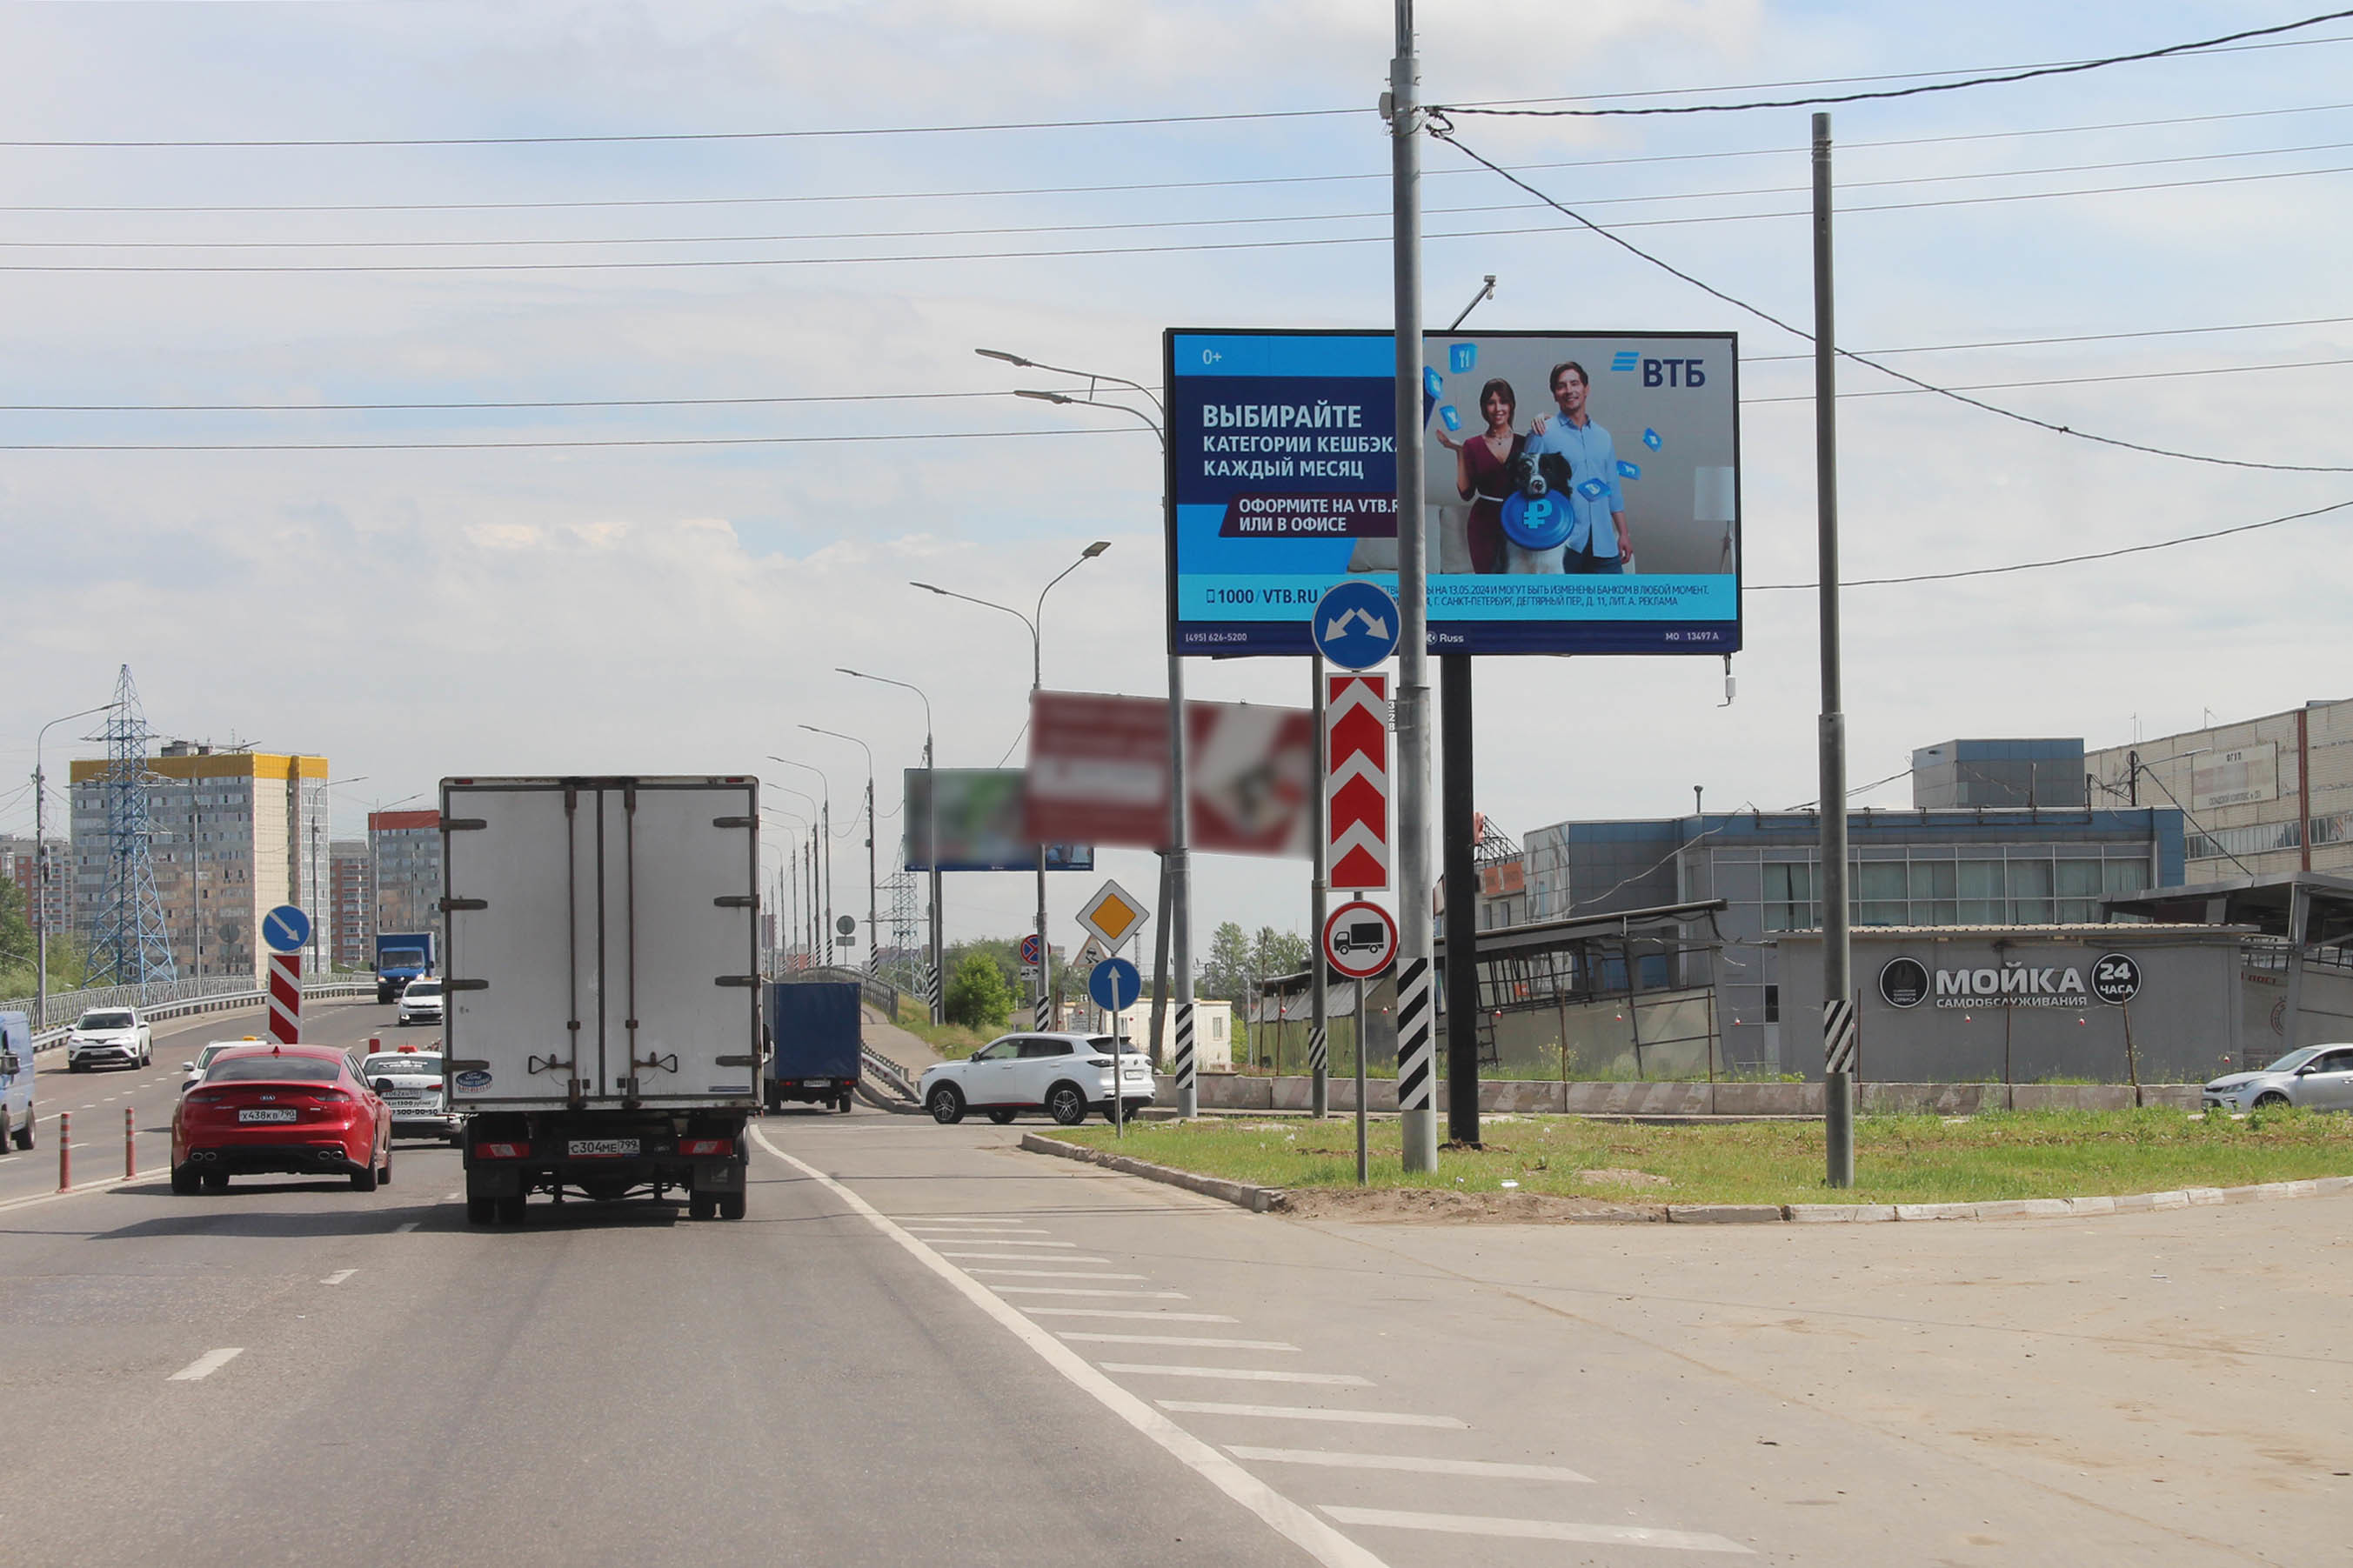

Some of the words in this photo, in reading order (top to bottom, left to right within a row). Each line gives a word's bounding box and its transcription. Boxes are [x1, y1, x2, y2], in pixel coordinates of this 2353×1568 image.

[1202, 349, 1222, 364] 0+
[1643, 358, 1706, 387] ВТБ
[1203, 399, 1362, 428] ВЫБИРАЙТЕ
[1203, 436, 1314, 452] КАТЕГОРИИ
[1317, 437, 1398, 453] КЕШБЭК
[1204, 457, 1294, 479] КАЖДЫЙ
[1300, 461, 1364, 479] МЕСЯЦ
[1239, 498, 1329, 513] ОФОРМИТЕ
[1333, 499, 1354, 513] НА
[1358, 499, 1398, 513] VTB.R
[1239, 517, 1273, 531] ИЛИ
[1277, 517, 1287, 530] В
[1291, 517, 1347, 531] ОФИСЕ
[1448, 585, 1489, 595] 13.05.2024
[1498, 585, 1525, 595] МОГУТ
[1527, 585, 1549, 595] БЫТЬ
[1550, 585, 1596, 595] ИЗМЕНЕНЫ
[1597, 585, 1633, 595] БАНКОМ
[1640, 584, 1672, 595] ЛЮБОЙ
[1672, 585, 1709, 595] МОМЕНТ.
[1515, 596, 1565, 607] ДЕГТЯРНЫЙ
[1639, 597, 1678, 606] РЕКЛАМА
[1208, 632, 1247, 642] 626-5200
[1440, 633, 1464, 643] Russ
[1687, 632, 1710, 641] 13497
[1935, 961, 2086, 994] МОЙКА
[2100, 963, 2131, 980] 24
[2099, 984, 2135, 995] ЧАСА
[1936, 996, 2088, 1008] САМООБСЛУЖИВАНИЯ
